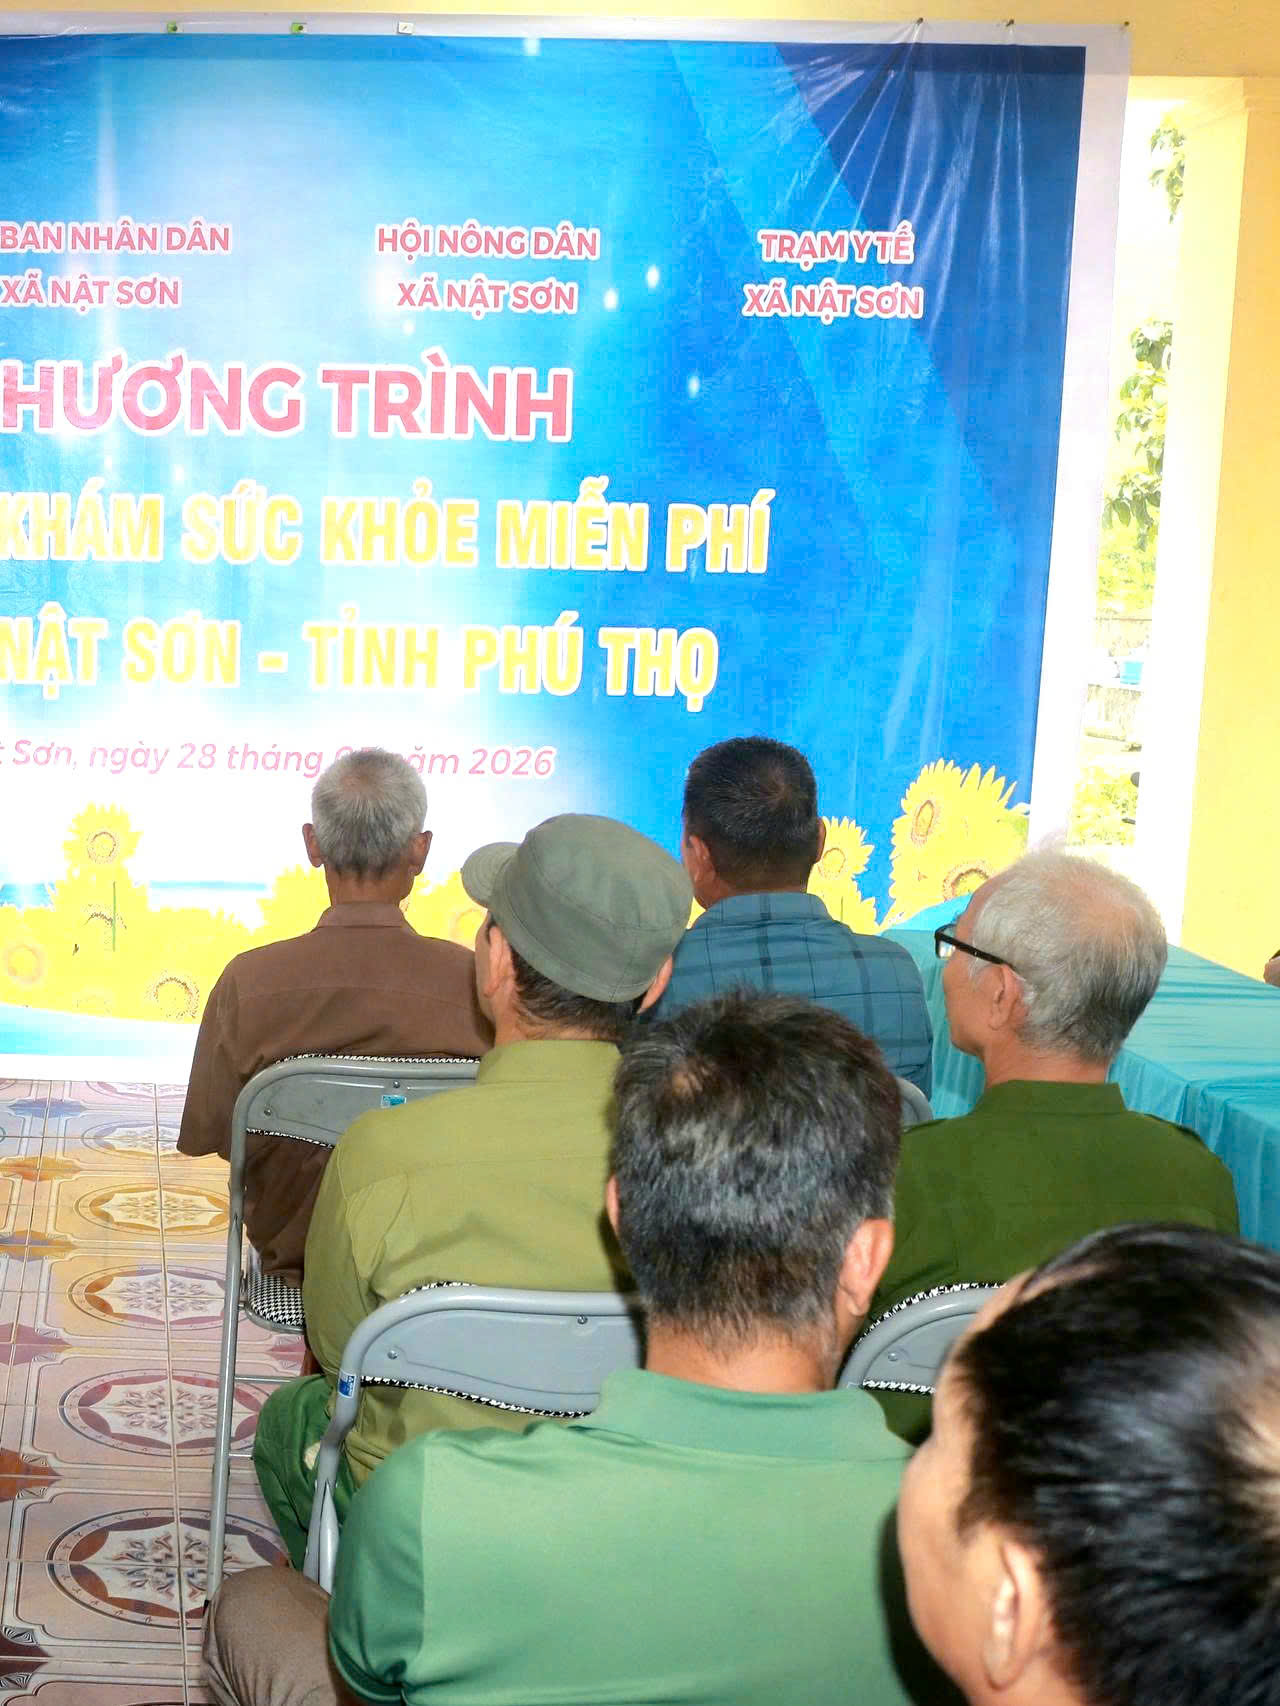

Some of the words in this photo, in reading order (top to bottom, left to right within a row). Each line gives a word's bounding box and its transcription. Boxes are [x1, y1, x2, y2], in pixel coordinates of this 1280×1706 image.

[70, 219, 158, 252] NHÂN
[165, 220, 230, 252] DÂN
[377, 221, 430, 261] HỘI
[438, 223, 526, 255] NÔNG
[532, 224, 598, 257] DÂN
[760, 233, 846, 268] TRẠM
[852, 234, 871, 260] Y
[875, 224, 913, 261] TẾ
[0, 272, 44, 304] XÃ
[50, 273, 111, 312] NẬT
[116, 276, 180, 306] SƠN
[397, 276, 440, 307] XÃ
[446, 277, 506, 317] NẬT
[511, 281, 576, 311] SƠN
[745, 282, 788, 313] XÃ
[794, 281, 854, 322] NẬT
[857, 286, 921, 315] SƠN
[322, 352, 573, 437] TRÌNH
[182, 479, 302, 564] SỨC
[320, 478, 479, 566] KHỎE
[497, 476, 648, 570] MIỄN
[666, 490, 774, 572] PHÍ
[124, 612, 241, 686] SƠN
[303, 602, 439, 690] TỈNH
[463, 611, 583, 695] PHÚ
[599, 627, 718, 711] THỌ
[12, 739, 77, 770] Sơn,
[89, 741, 170, 774] ngày
[177, 743, 217, 769] 28
[227, 743, 323, 778] tháng
[406, 745, 460, 774] ăm
[468, 748, 556, 776] 2026
